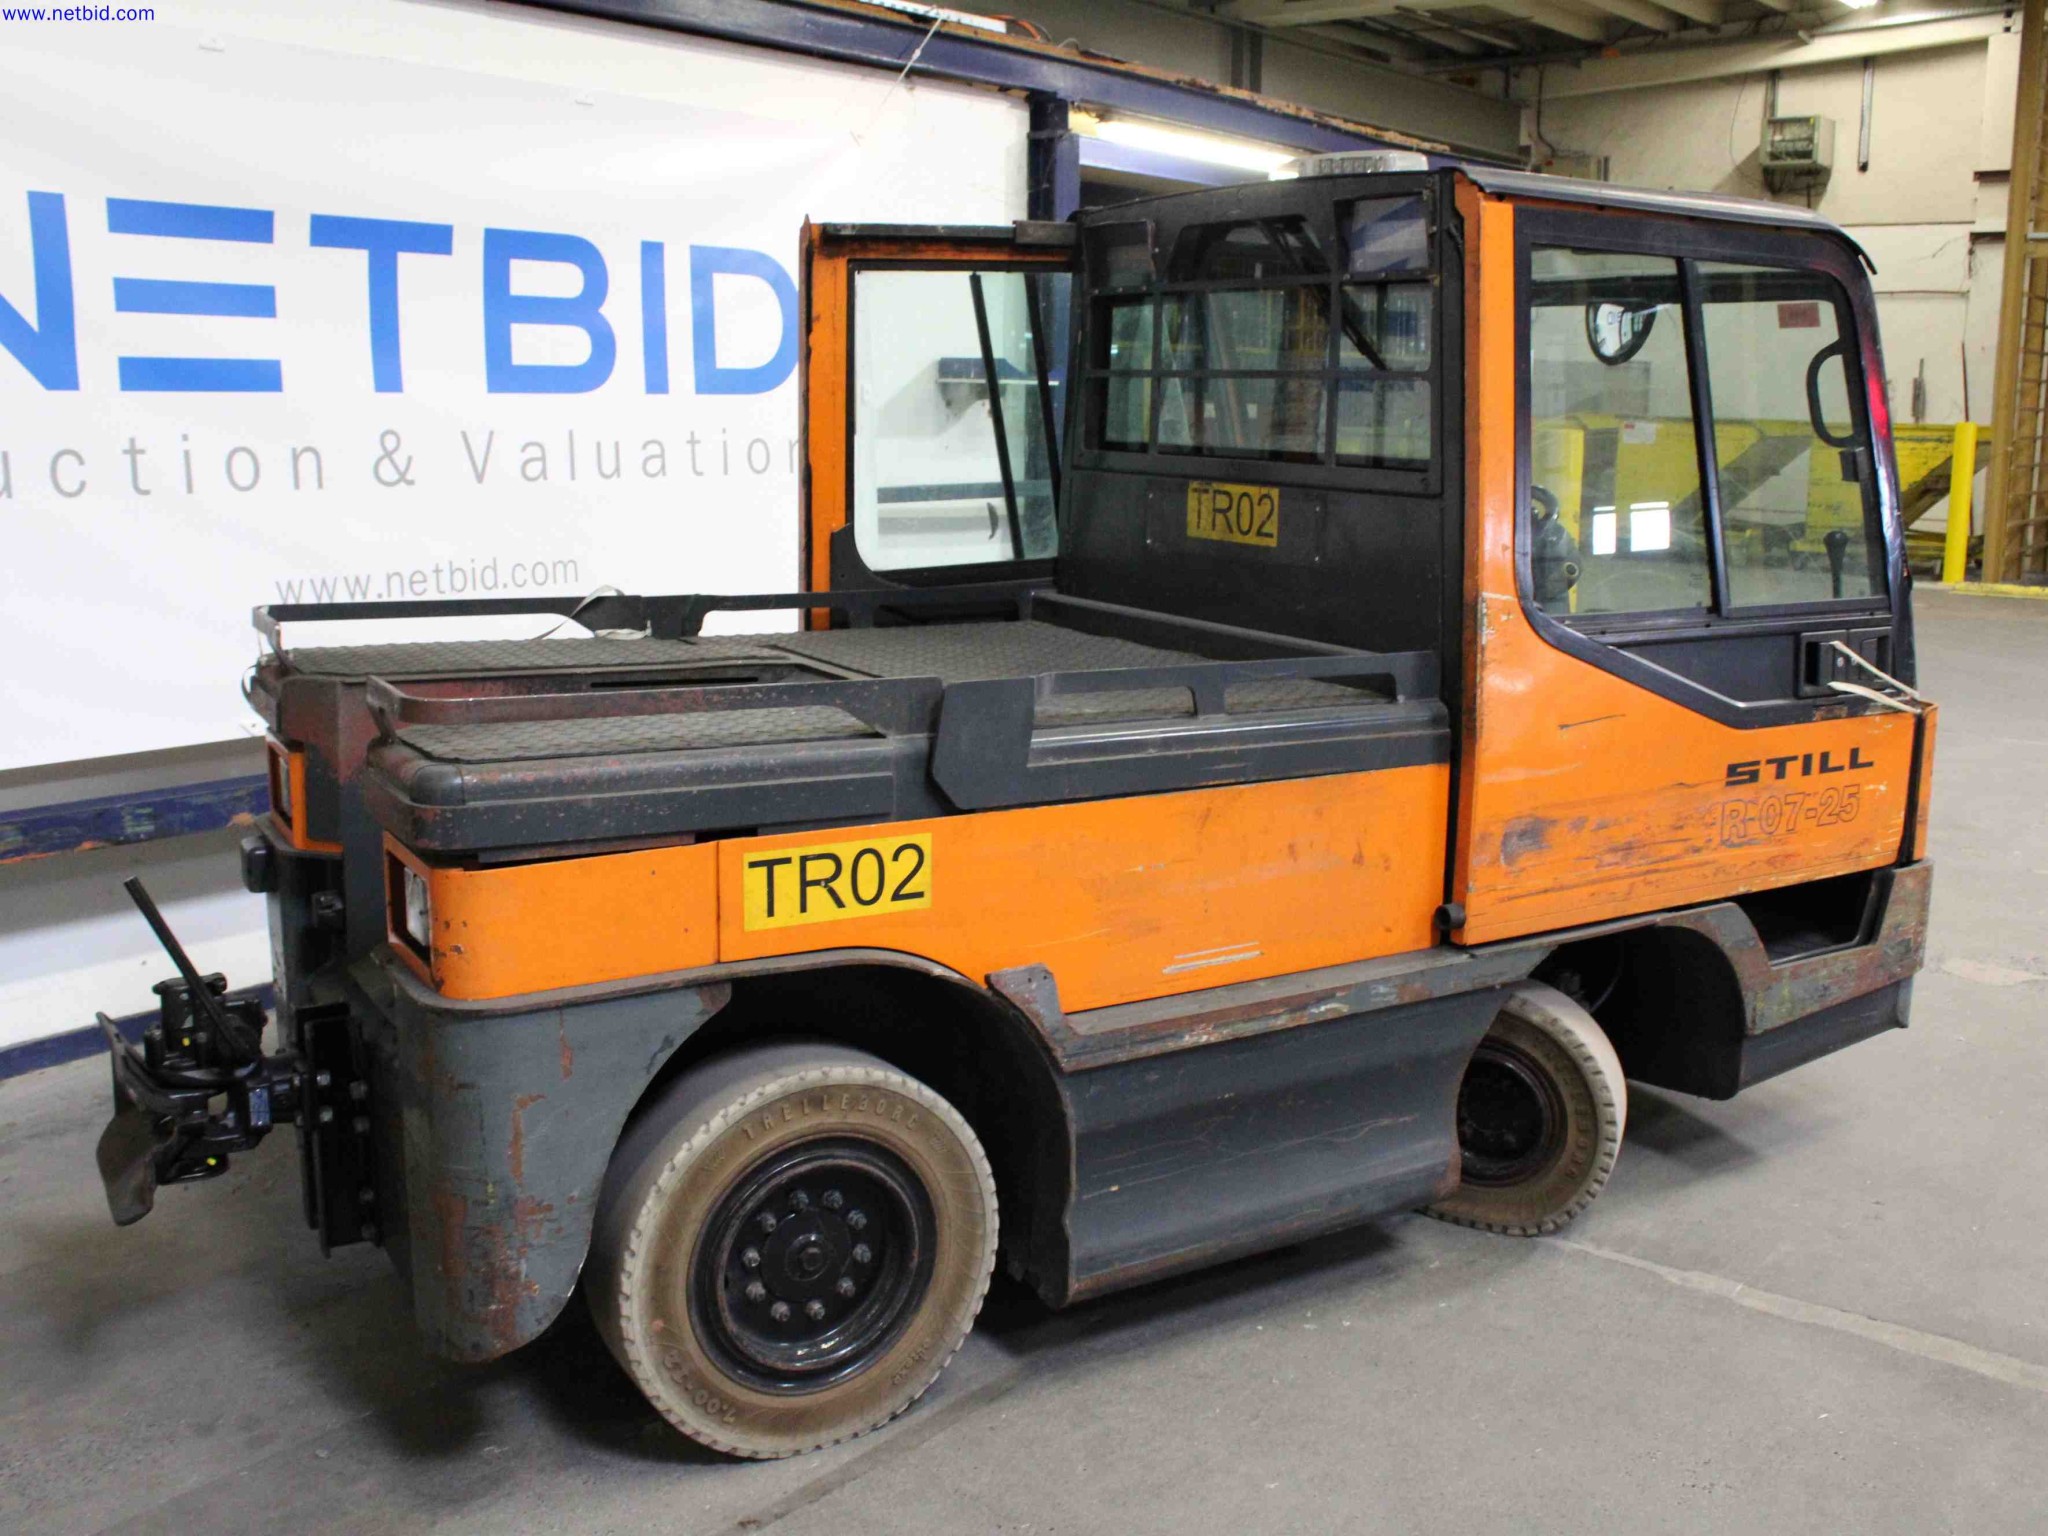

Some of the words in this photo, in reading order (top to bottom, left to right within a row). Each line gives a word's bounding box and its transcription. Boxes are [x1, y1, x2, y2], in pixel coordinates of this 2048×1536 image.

[373, 428, 416, 487] &
[1191, 487, 1275, 538] TR02
[276, 557, 580, 603] www.netbid.com
[1725, 747, 1875, 787] STILL
[748, 843, 925, 918] TR02
